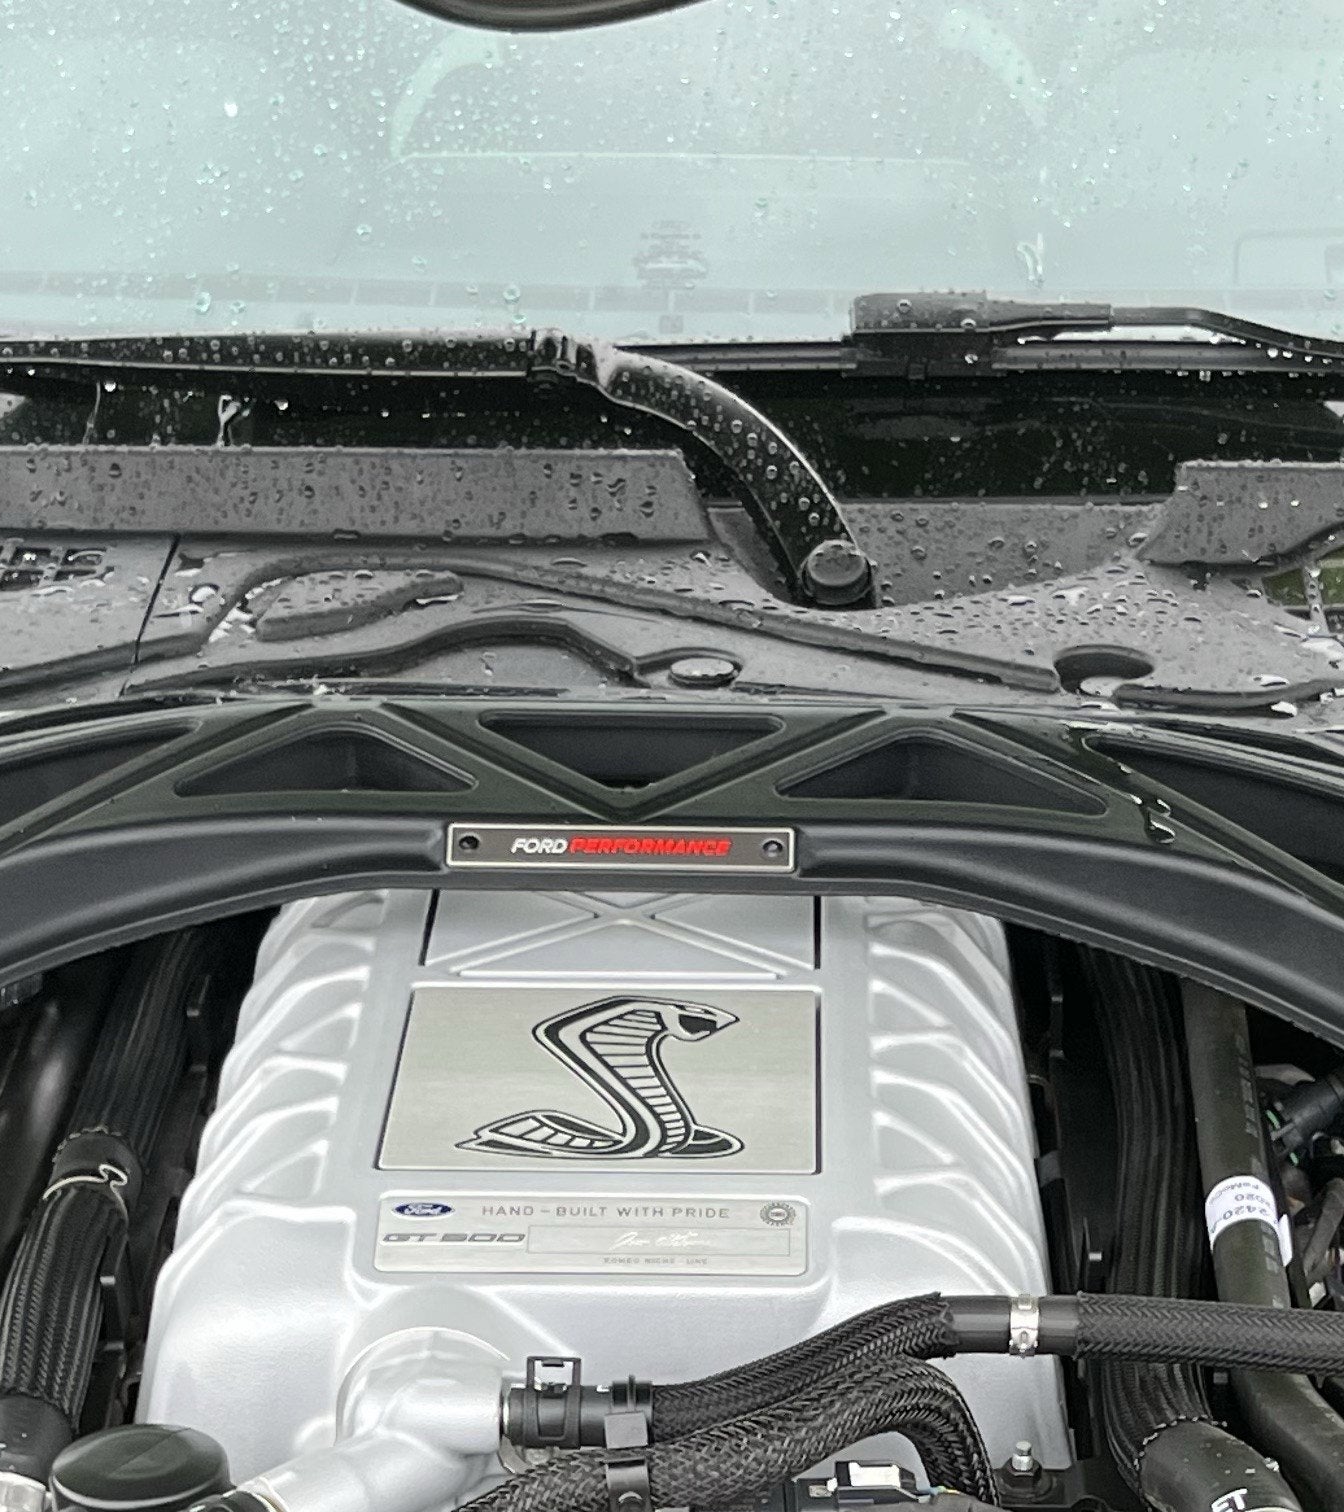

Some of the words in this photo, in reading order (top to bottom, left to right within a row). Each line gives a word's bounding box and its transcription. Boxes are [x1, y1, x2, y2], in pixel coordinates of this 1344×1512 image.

[511, 837, 567, 854] FORD
[568, 836, 732, 857] PERFORMANCE
[481, 1206, 534, 1217] HAND
[555, 1206, 607, 1218] BUILT
[616, 1207, 664, 1218] WITH
[671, 1207, 730, 1219] PRIDE
